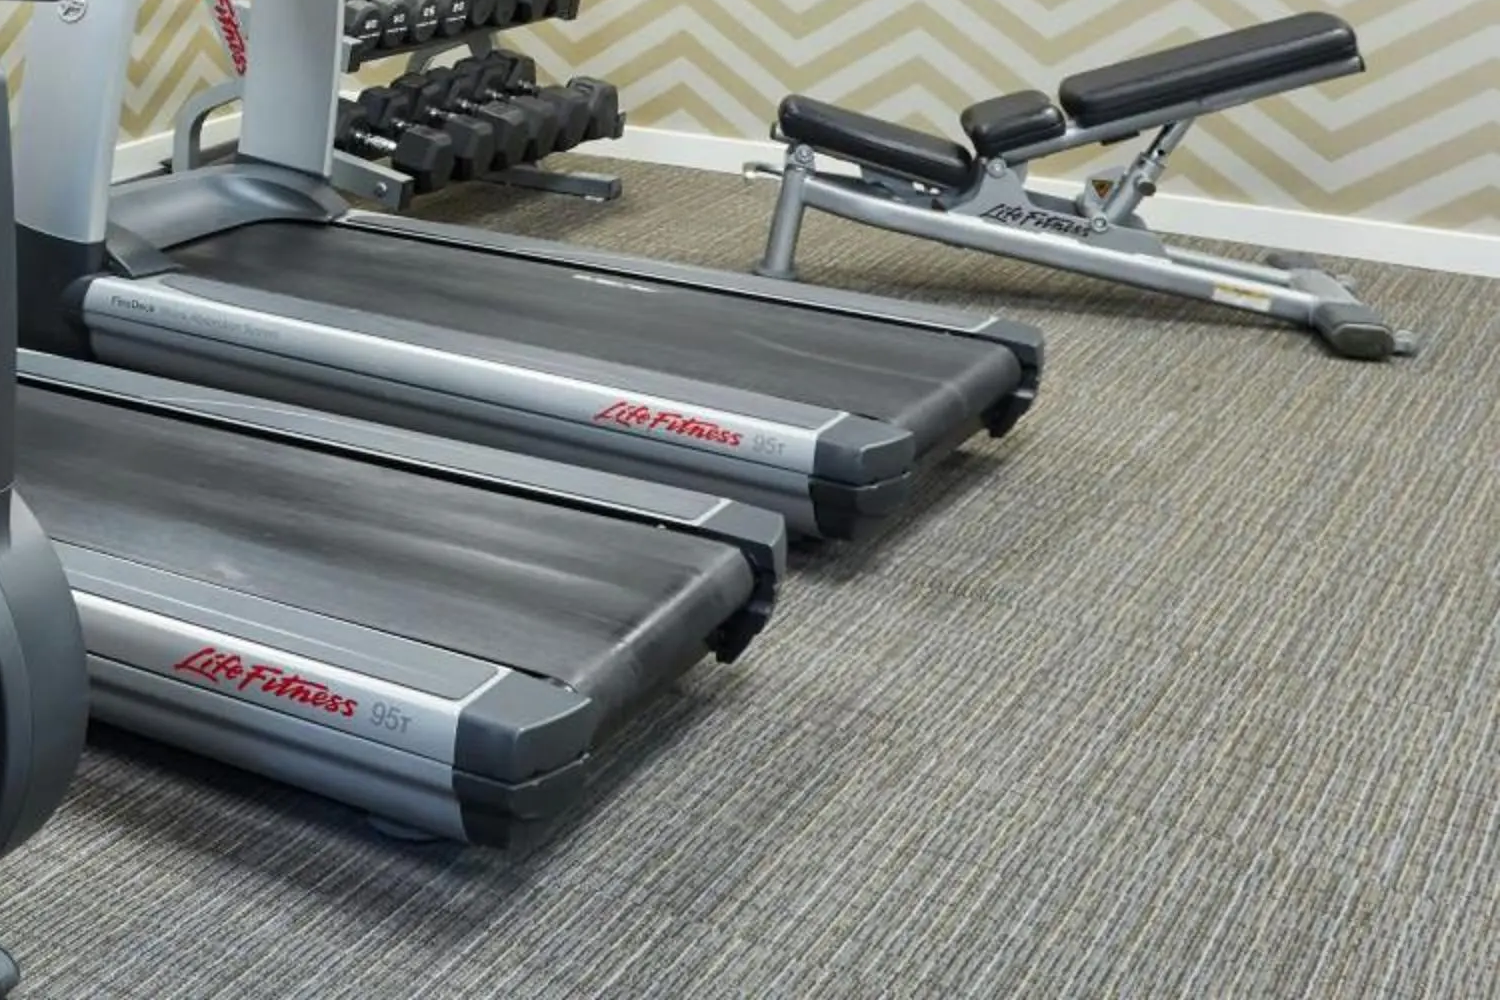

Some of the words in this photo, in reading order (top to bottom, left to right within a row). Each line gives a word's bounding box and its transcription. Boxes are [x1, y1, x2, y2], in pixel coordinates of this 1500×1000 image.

[980, 203, 1024, 223] Life
[1020, 211, 1093, 237] Fitness
[593, 401, 650, 428] Life
[649, 412, 744, 447] Fitness
[173, 646, 245, 683] Life
[237, 665, 359, 718] Fitness
[369, 700, 413, 734] 95T
